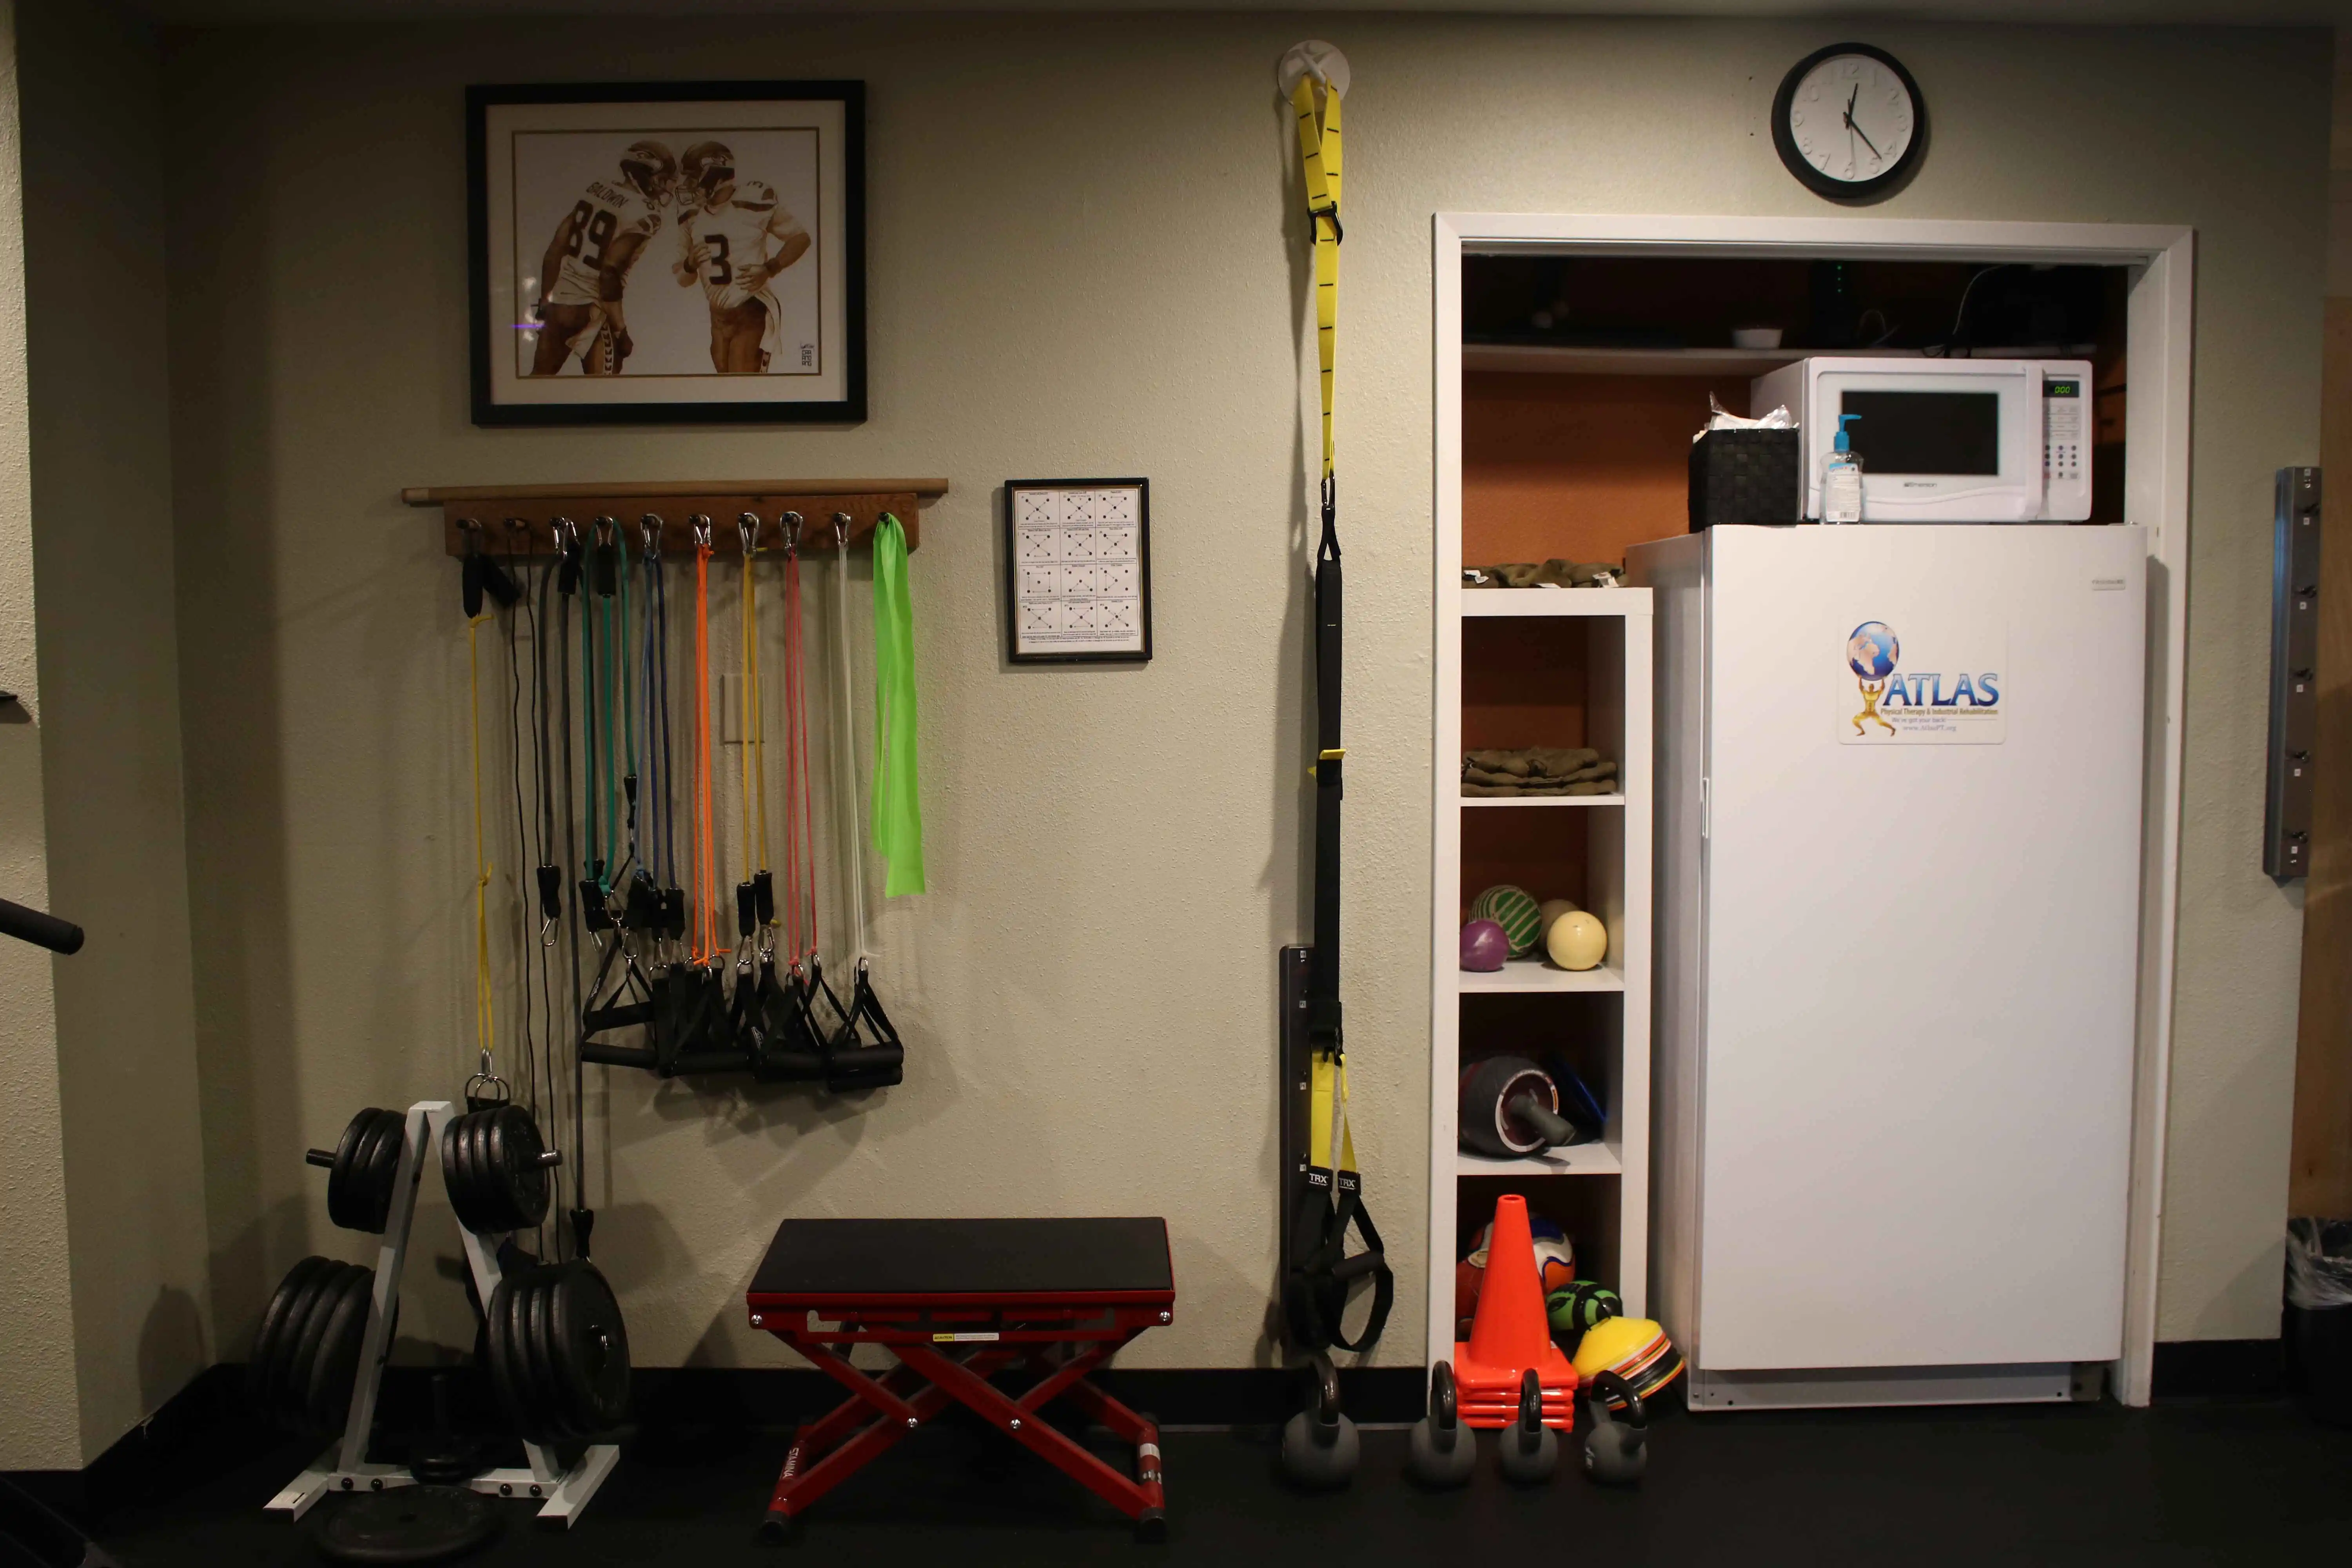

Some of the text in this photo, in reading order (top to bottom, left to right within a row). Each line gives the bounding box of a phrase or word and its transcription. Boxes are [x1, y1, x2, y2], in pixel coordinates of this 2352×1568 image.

[586, 182, 630, 209] BALDWIN
[567, 199, 617, 270] 89
[704, 234, 732, 285] 3
[1882, 673, 2000, 706] ATLAS
[1904, 708, 1925, 716] Therapy
[1309, 1173, 1327, 1184] TRX
[1339, 1178, 1355, 1188] TRX
[782, 1447, 799, 1479] STAMINA
